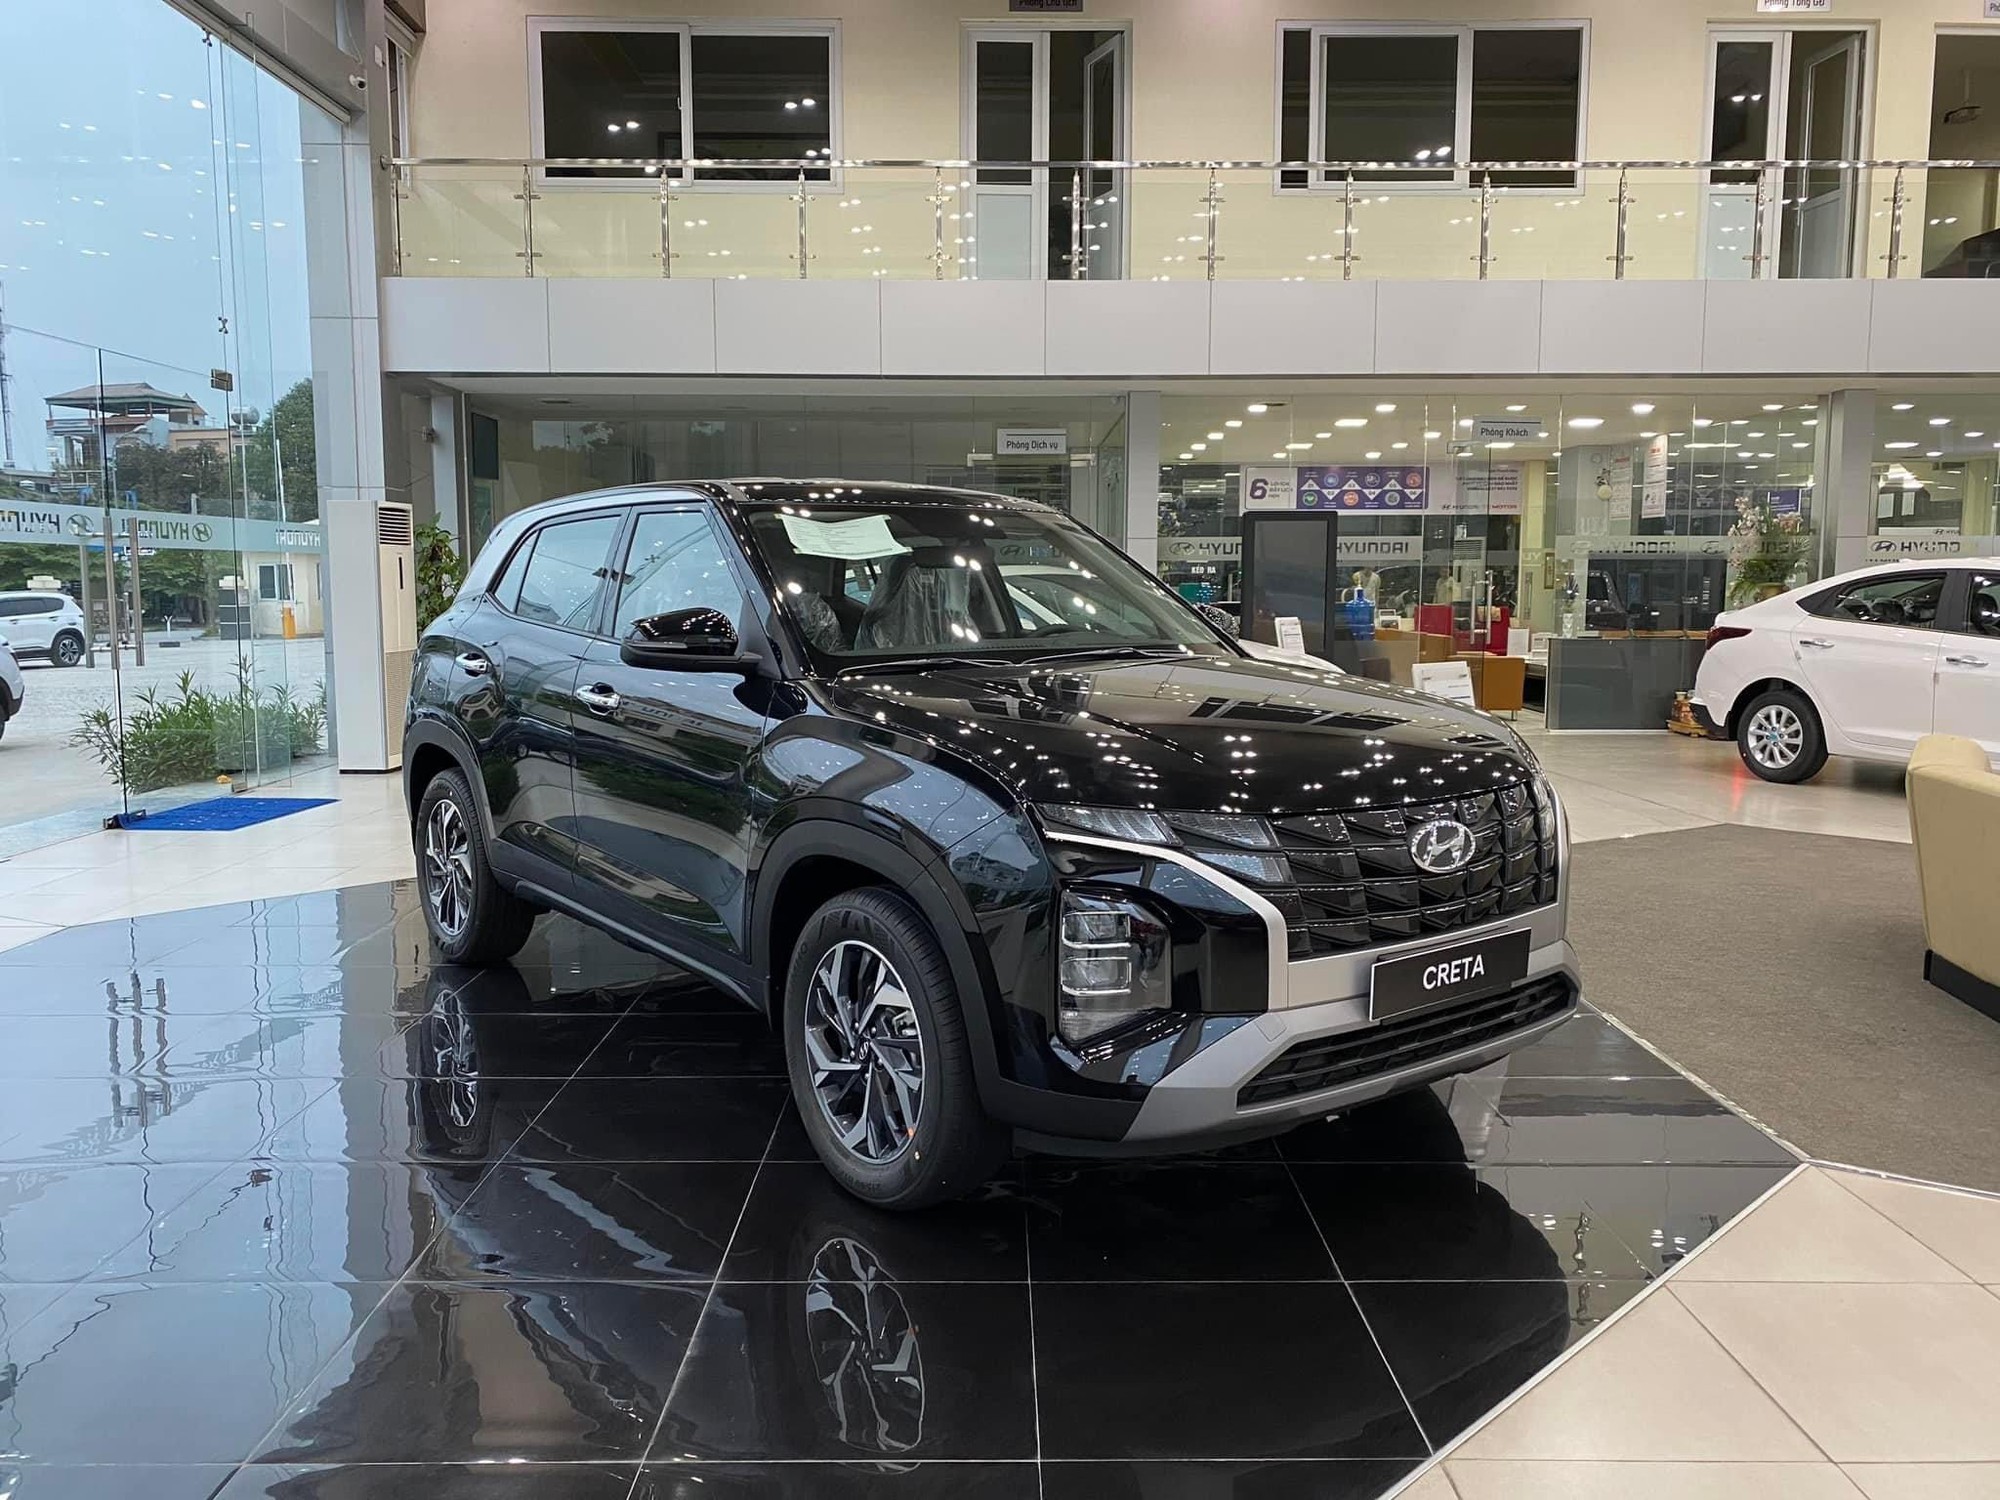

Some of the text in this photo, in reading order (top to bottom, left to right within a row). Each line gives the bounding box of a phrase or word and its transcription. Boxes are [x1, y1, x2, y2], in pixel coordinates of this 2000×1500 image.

[1481, 427, 1529, 438] Phòng Khách
[1006, 440, 1029, 451] Phòng
[1031, 440, 1048, 450] Dịch
[1250, 478, 1269, 500] 6
[1200, 543, 1242, 555] HYUN
[1901, 541, 1960, 553] HYUND
[1207, 566, 1217, 574] RA
[1423, 954, 1485, 990] CRETA
